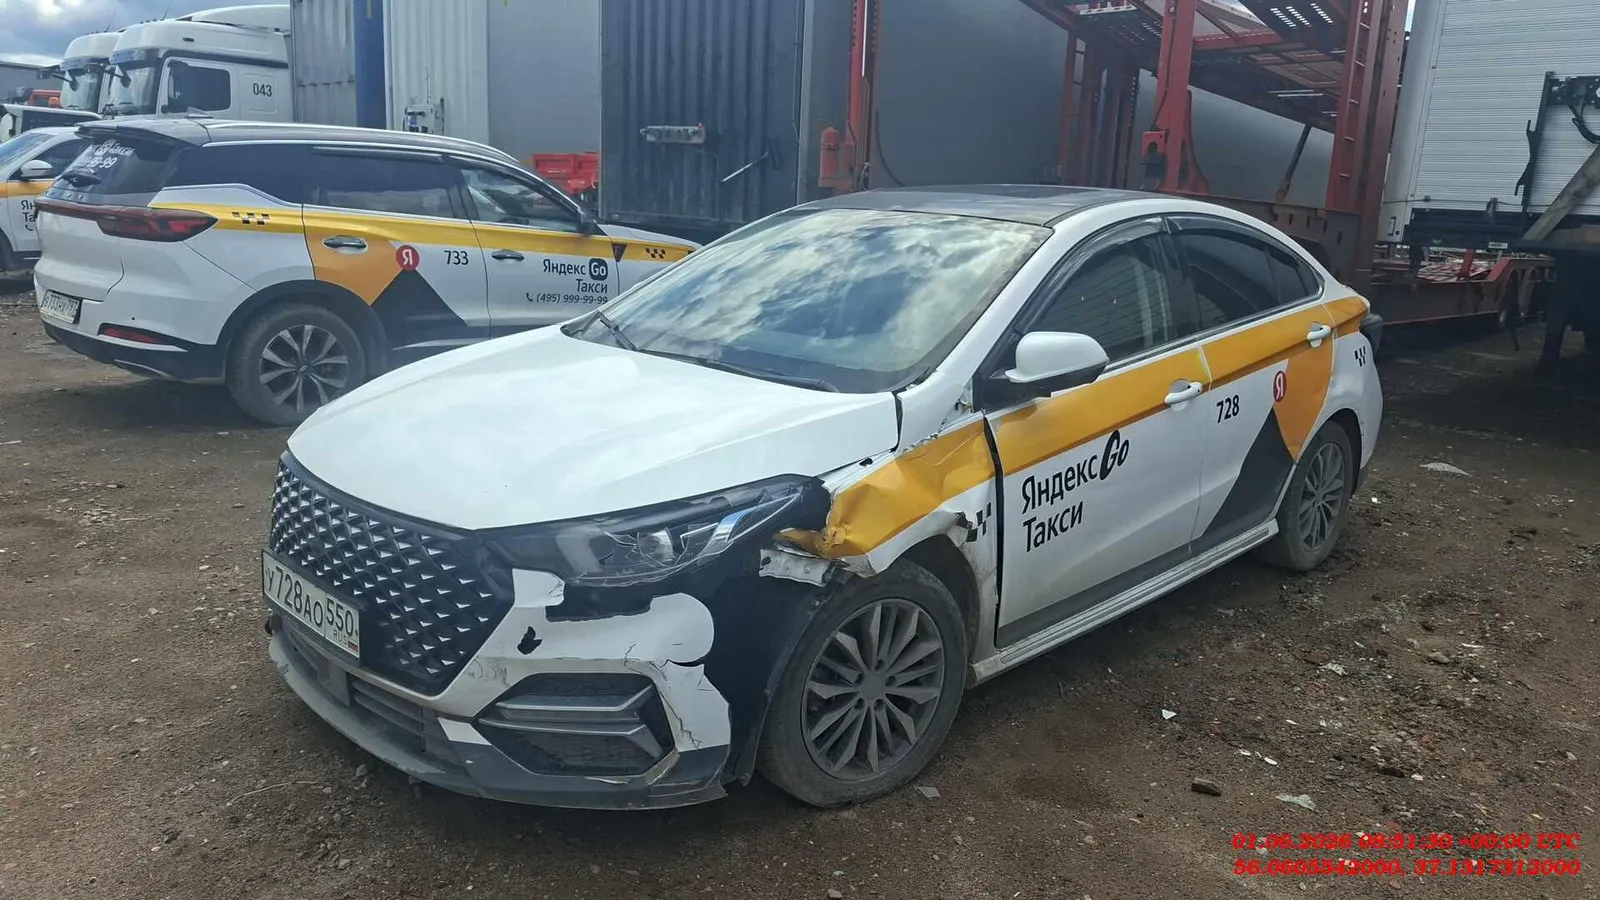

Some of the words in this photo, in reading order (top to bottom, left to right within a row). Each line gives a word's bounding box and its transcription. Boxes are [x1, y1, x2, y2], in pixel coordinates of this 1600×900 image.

[253, 82, 273, 97] 043
[444, 250, 469, 265] 733
[543, 258, 586, 276] Яндекс
[590, 262, 607, 276] Go
[575, 278, 608, 293] Такси
[536, 293, 561, 304] (495)
[563, 294, 608, 305] 999-99-99
[1216, 394, 1240, 424] 728
[1021, 454, 1098, 514] Яндекс
[1100, 429, 1130, 480] Go
[1022, 501, 1083, 553] Такси
[326, 597, 354, 637] 550
[333, 629, 348, 646] RUS
